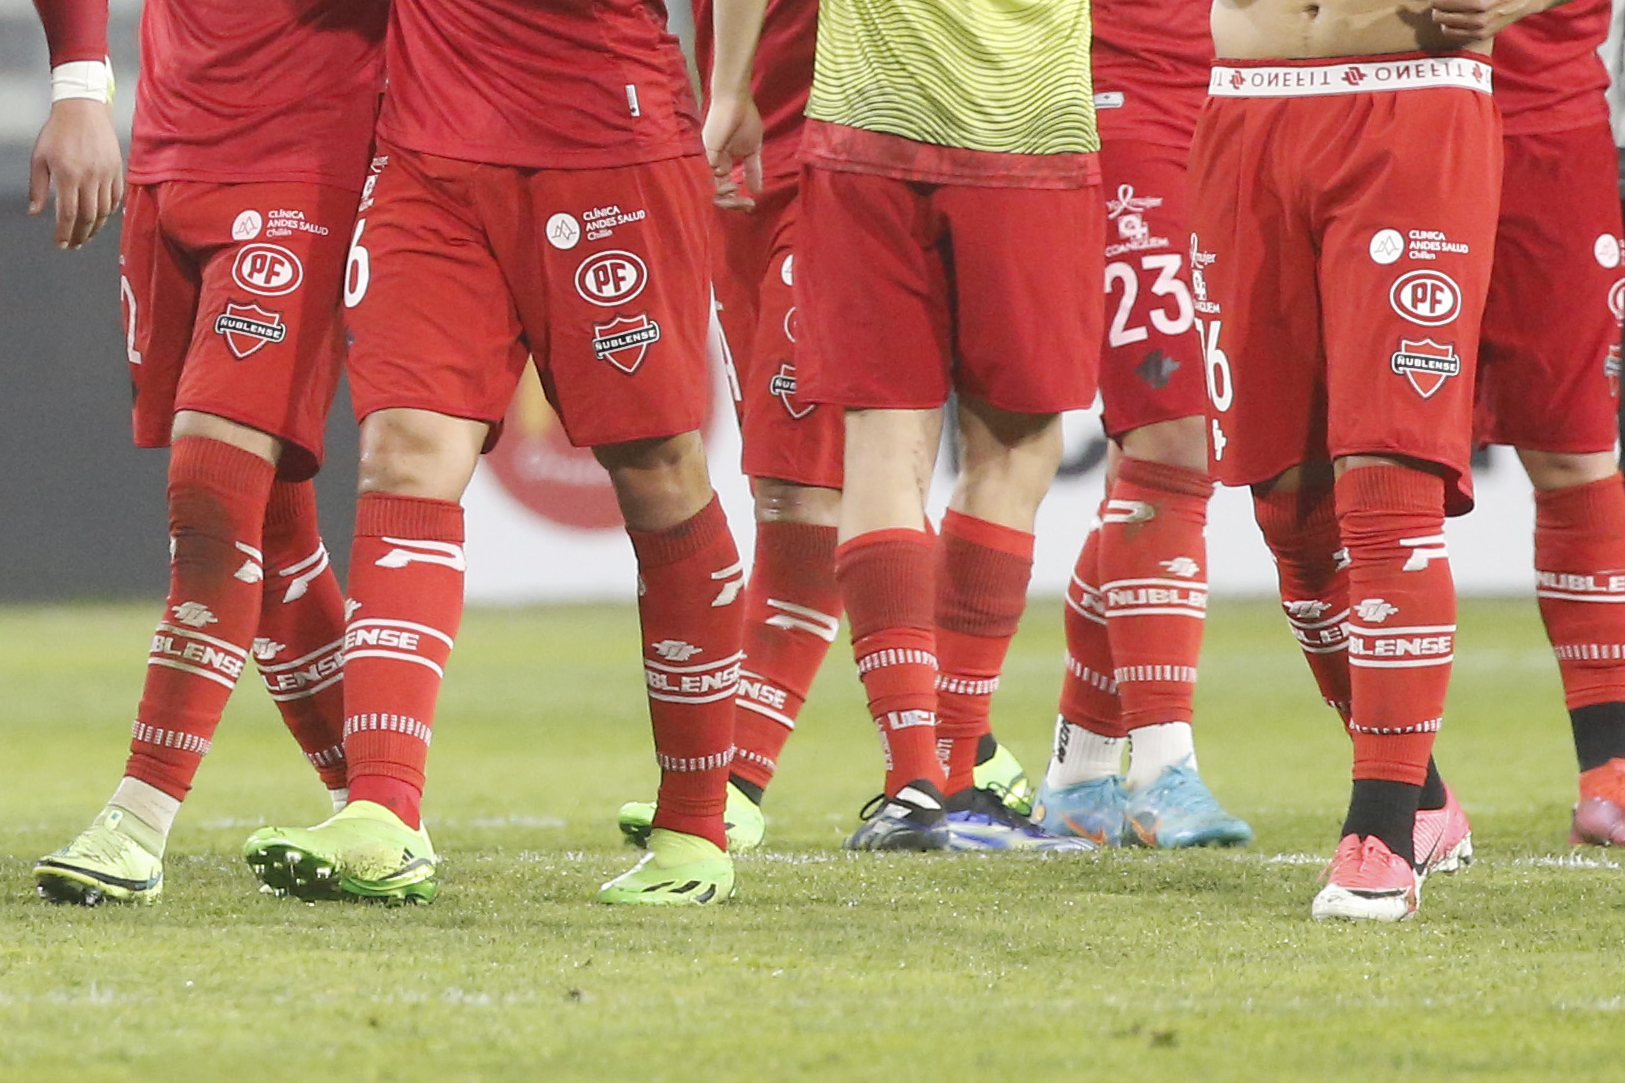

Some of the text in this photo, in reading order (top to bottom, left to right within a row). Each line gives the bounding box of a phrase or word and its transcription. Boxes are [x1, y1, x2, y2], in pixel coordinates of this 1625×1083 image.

[266, 219, 298, 229] ANDES
[1409, 241, 1440, 251] ANDES
[247, 254, 285, 284] PF
[593, 262, 627, 294] PF
[1104, 254, 1195, 348] 23
[1411, 282, 1444, 313] PF
[1107, 586, 1206, 608] ÑUBLE
[344, 628, 420, 651] ENSE
[1349, 636, 1452, 656] BLENSE
[150, 633, 244, 678] BLENSE
[261, 648, 345, 692] LENSE
[647, 661, 741, 693] BLENSE
